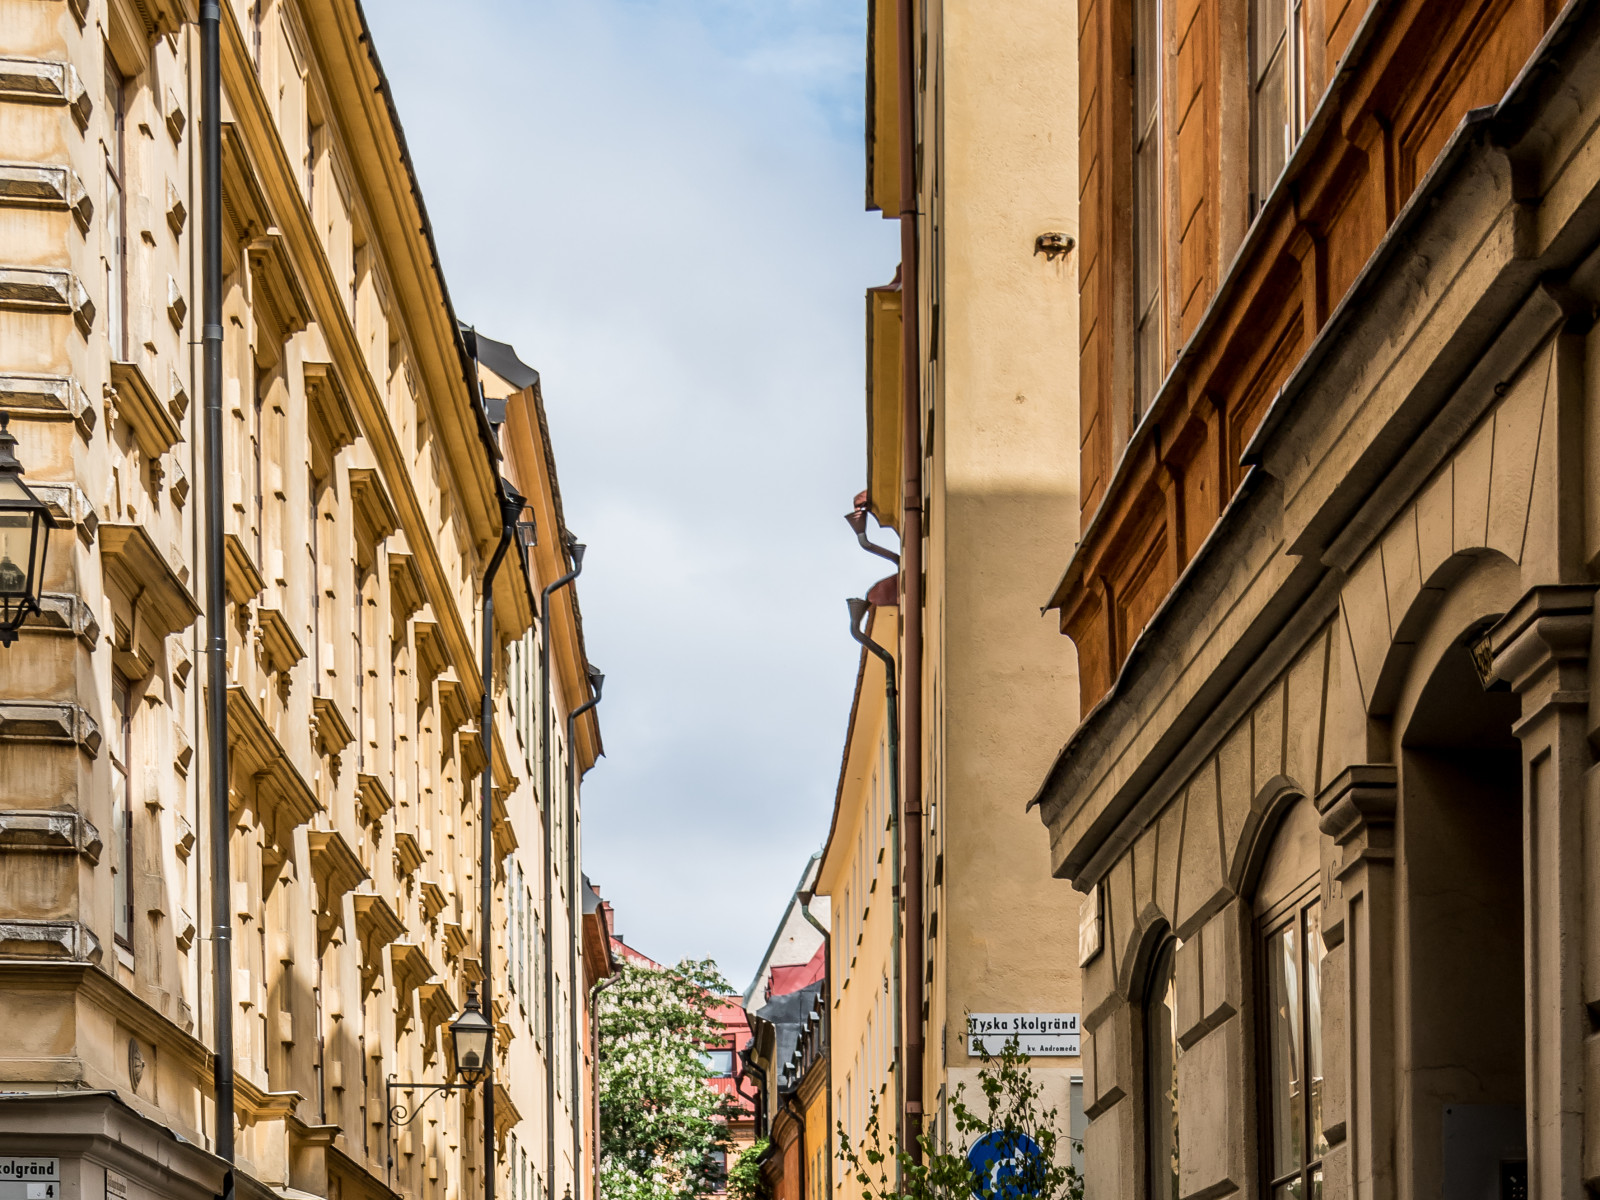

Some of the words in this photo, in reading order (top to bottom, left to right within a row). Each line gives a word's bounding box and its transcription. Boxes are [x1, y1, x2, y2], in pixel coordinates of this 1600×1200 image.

[971, 1017, 1008, 1032] Tyska
[1013, 1017, 1076, 1032] Skolgränd
[0, 1160, 54, 1179] olgränd
[46, 1184, 54, 1198] 4
